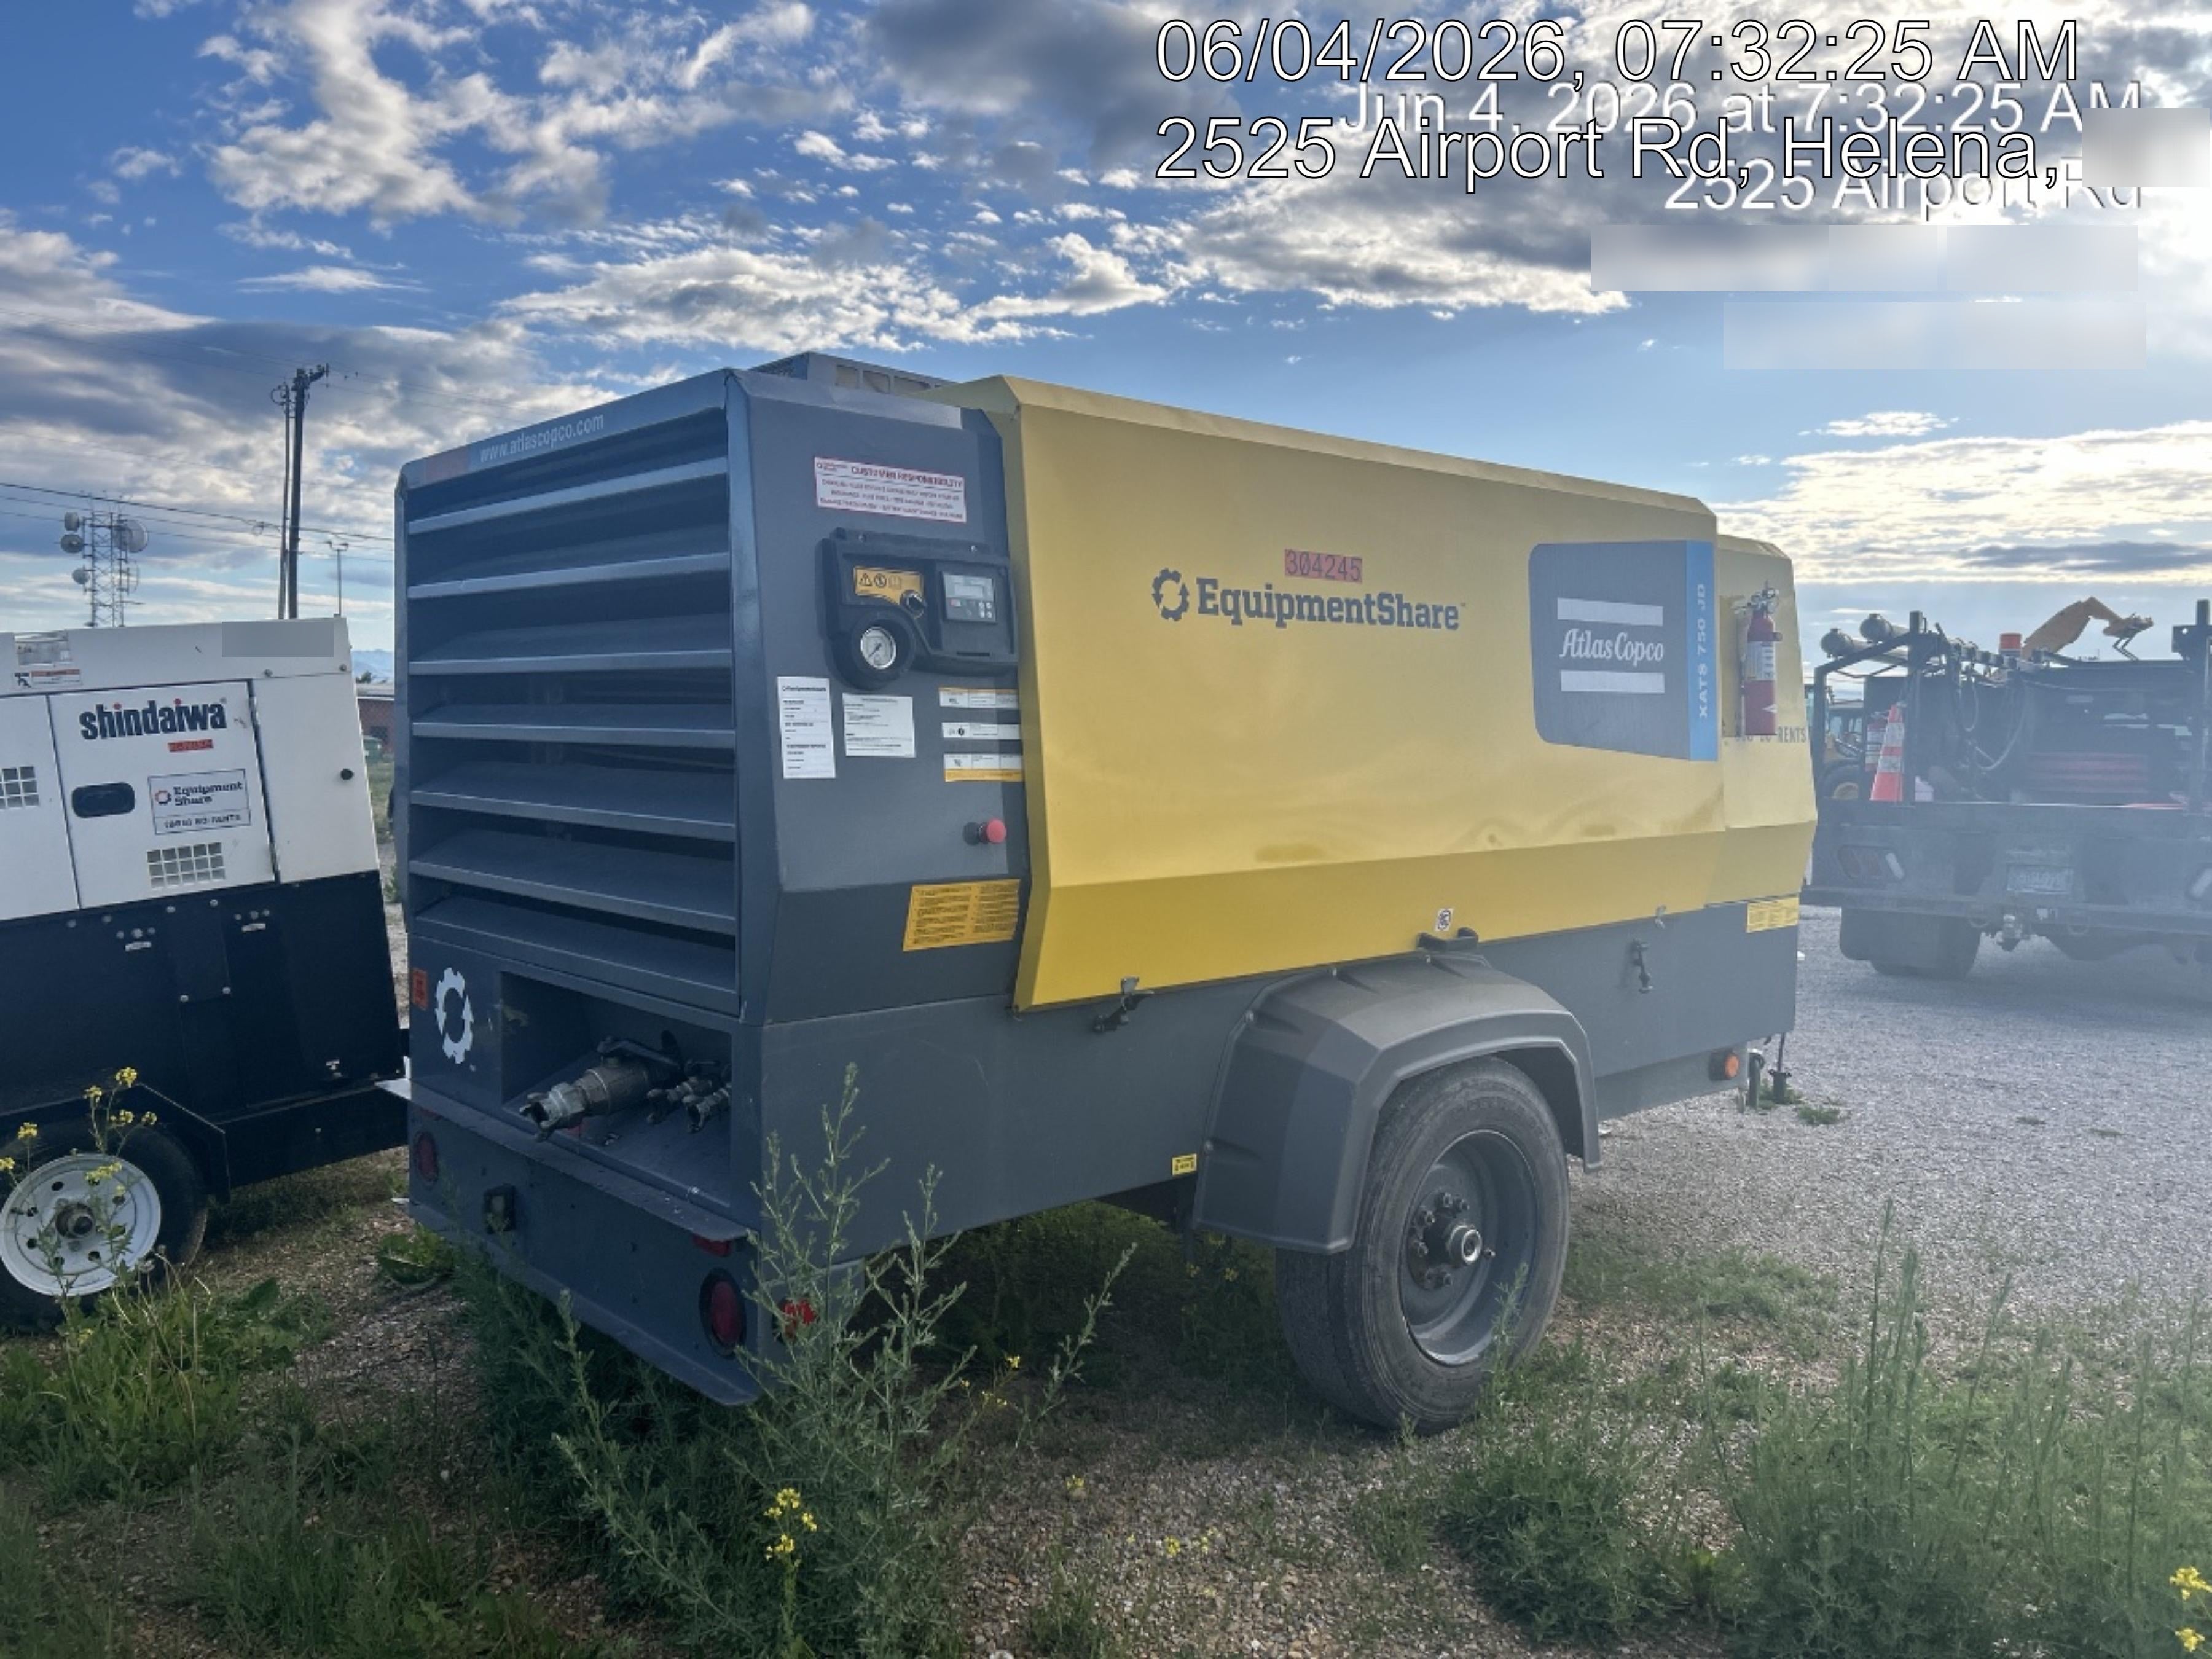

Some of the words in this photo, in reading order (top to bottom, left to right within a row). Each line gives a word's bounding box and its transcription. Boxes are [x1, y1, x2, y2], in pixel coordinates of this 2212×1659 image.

[480, 413, 605, 463] www.atlascopco.com
[1285, 550, 1362, 582] 304245
[1196, 577, 1460, 630] EquipmentShare
[1697, 584, 1706, 610] JD
[1697, 618, 1706, 656] 750
[79, 698, 227, 740] shindaiwa
